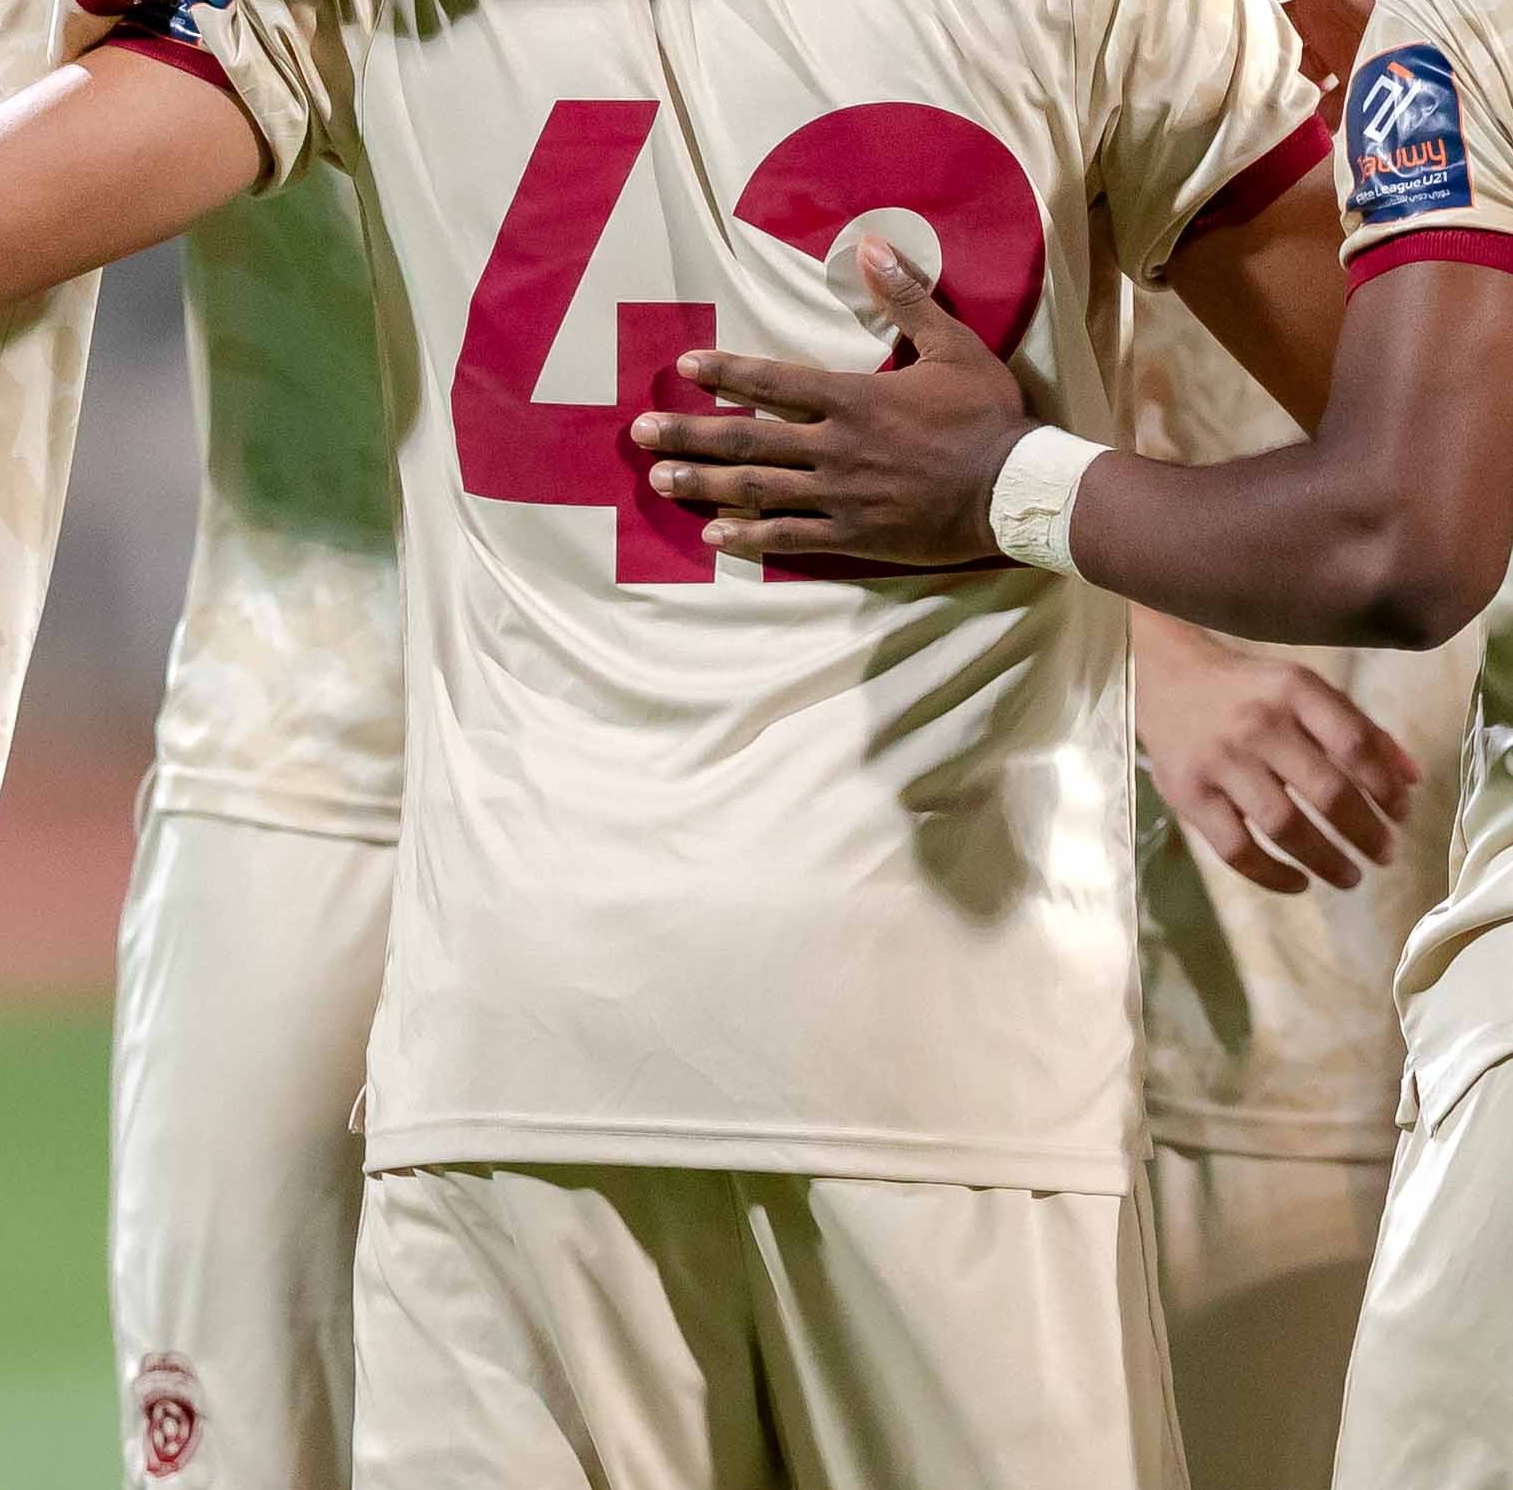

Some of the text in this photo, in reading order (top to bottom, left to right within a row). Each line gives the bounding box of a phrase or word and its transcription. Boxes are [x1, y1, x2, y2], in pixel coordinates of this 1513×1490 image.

[1374, 179, 1421, 198] League
[1422, 171, 1448, 186] U21
[450, 99, 1045, 584] 42
